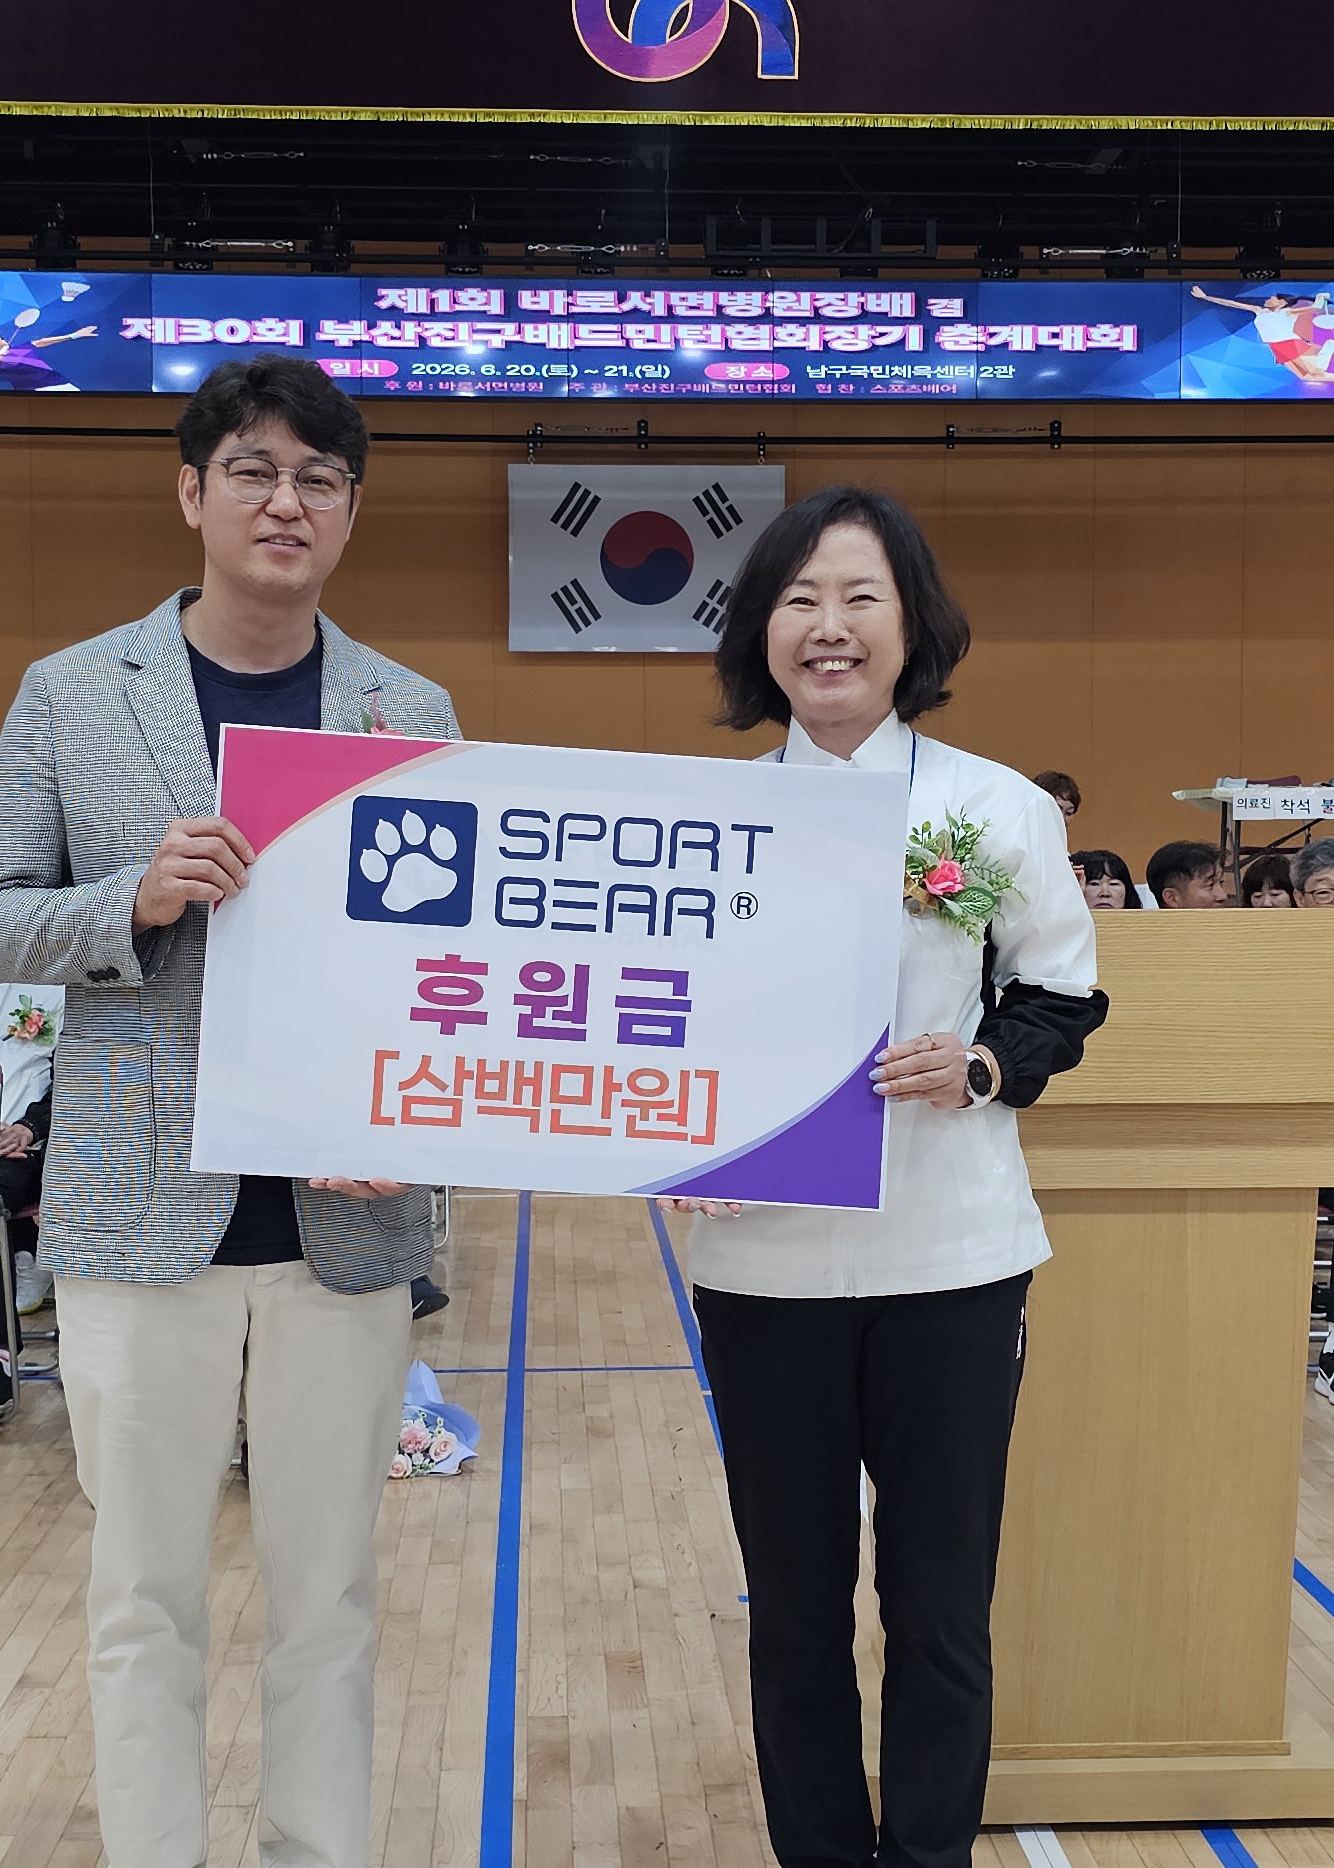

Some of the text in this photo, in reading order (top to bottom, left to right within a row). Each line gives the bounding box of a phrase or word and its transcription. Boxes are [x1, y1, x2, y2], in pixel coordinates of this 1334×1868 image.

[373, 286, 965, 318] 제1회 바로서면병원장배 겸
[119, 316, 1138, 352] 제30회 부산진구배드민턴협회장기 춘계대회
[411, 363, 476, 377] 2026.
[806, 364, 977, 379] 남구국민체육센터
[979, 365, 1016, 379] 2관
[1235, 797, 1272, 810] 의료진
[1280, 798, 1311, 815] 착석
[498, 807, 774, 876] SPORT
